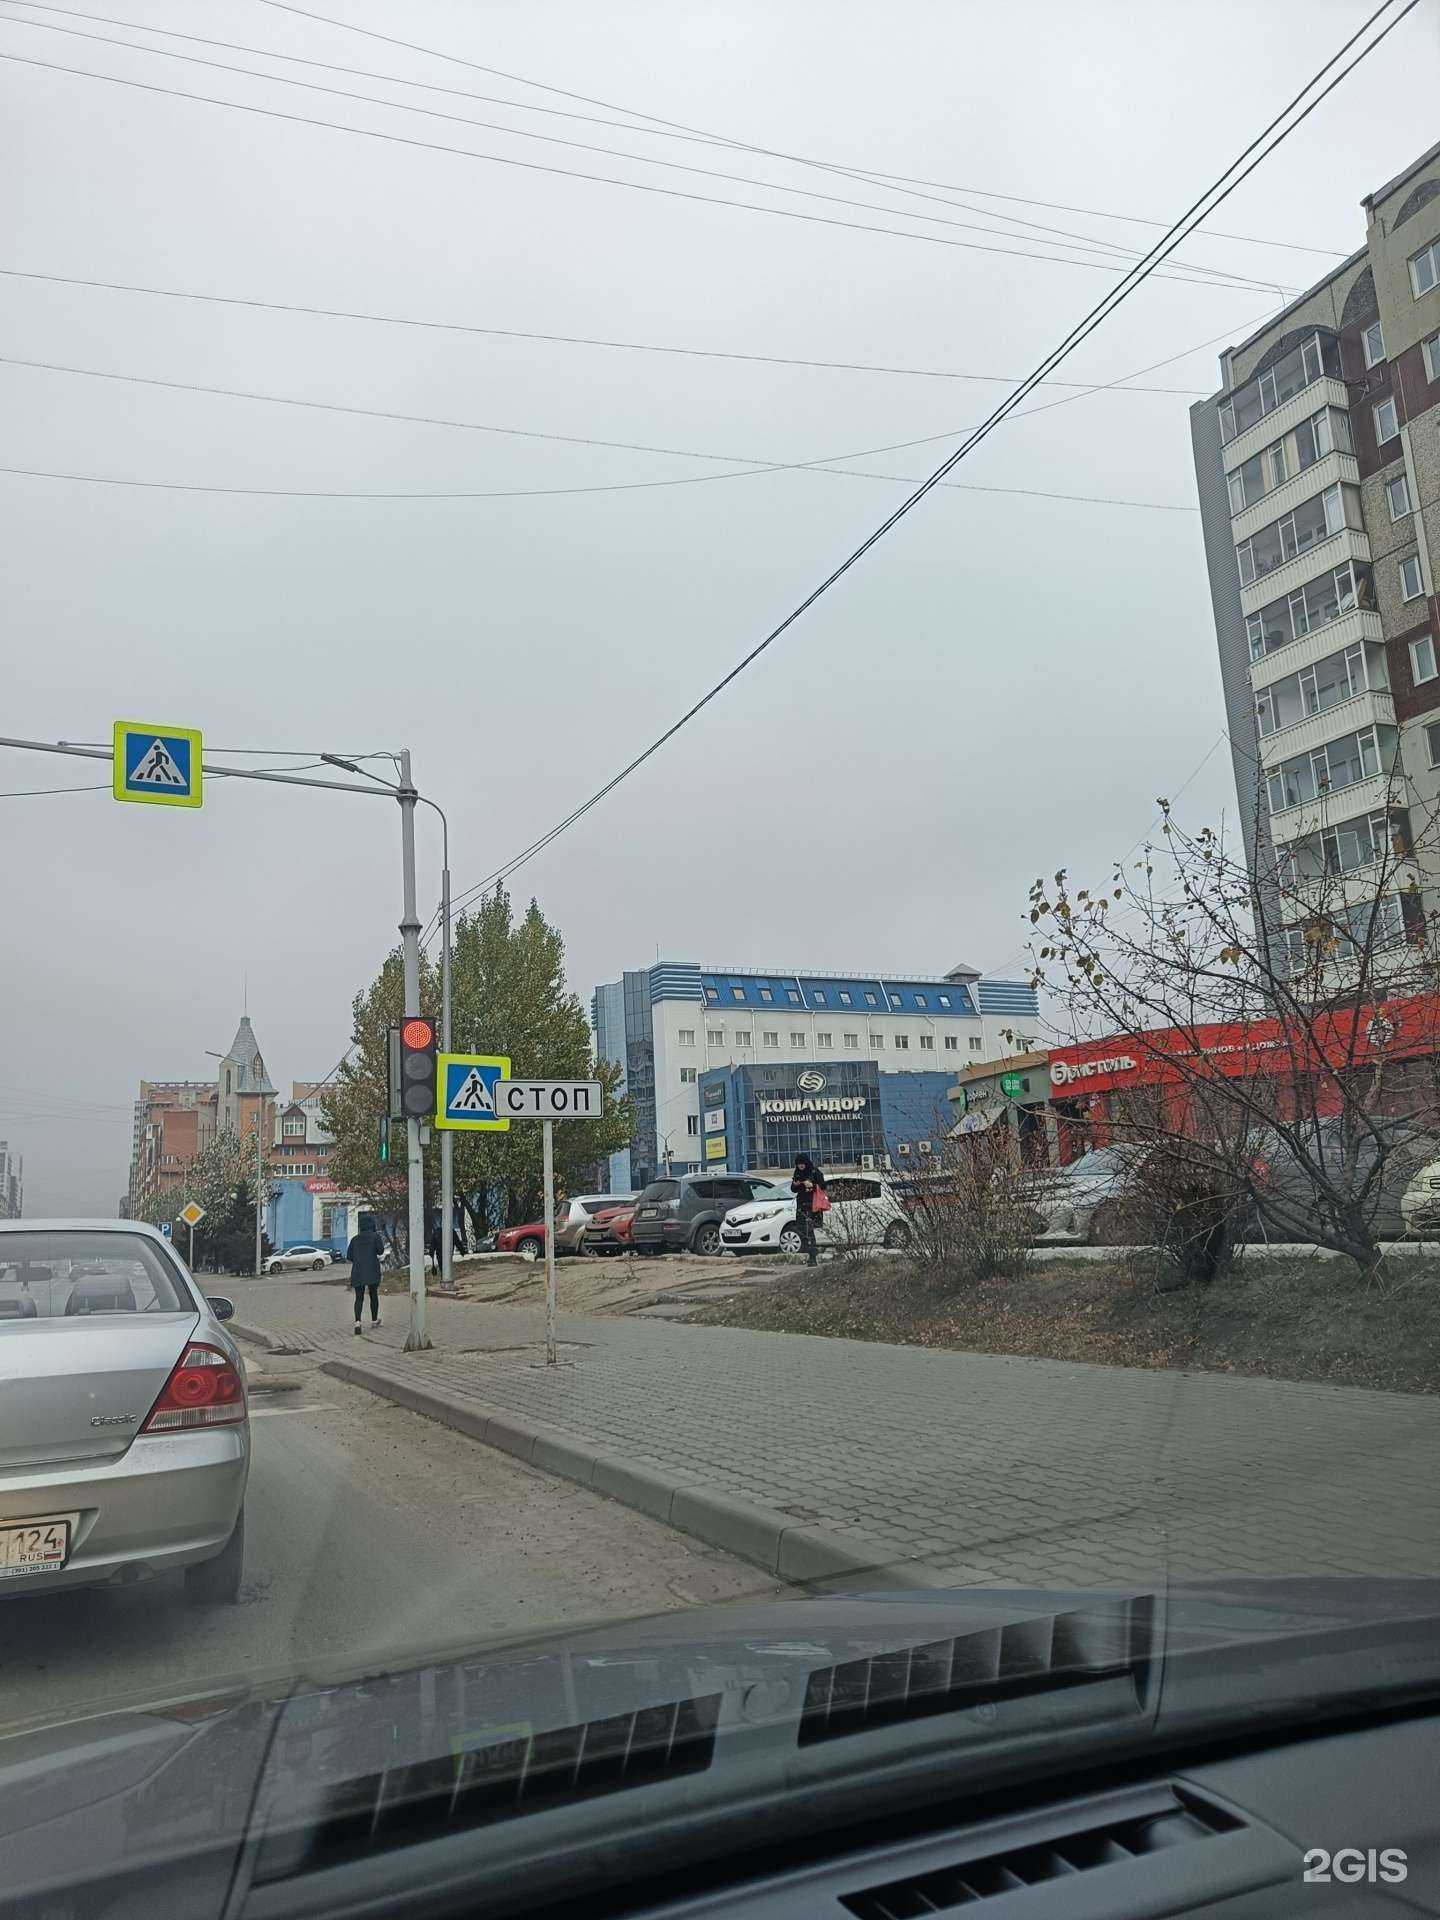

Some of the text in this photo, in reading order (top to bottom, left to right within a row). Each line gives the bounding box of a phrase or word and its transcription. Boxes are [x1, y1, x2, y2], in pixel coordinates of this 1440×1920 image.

[507, 1087, 589, 1111] СТОП
[760, 1097, 866, 1115] КОМАНДОР
[766, 1112, 863, 1123] ТОРГОВЫЙ КОМПЛЕКС
[91, 1413, 136, 1427] Classic
[15, 1527, 58, 1554] 124
[19, 1552, 44, 1563] RUS
